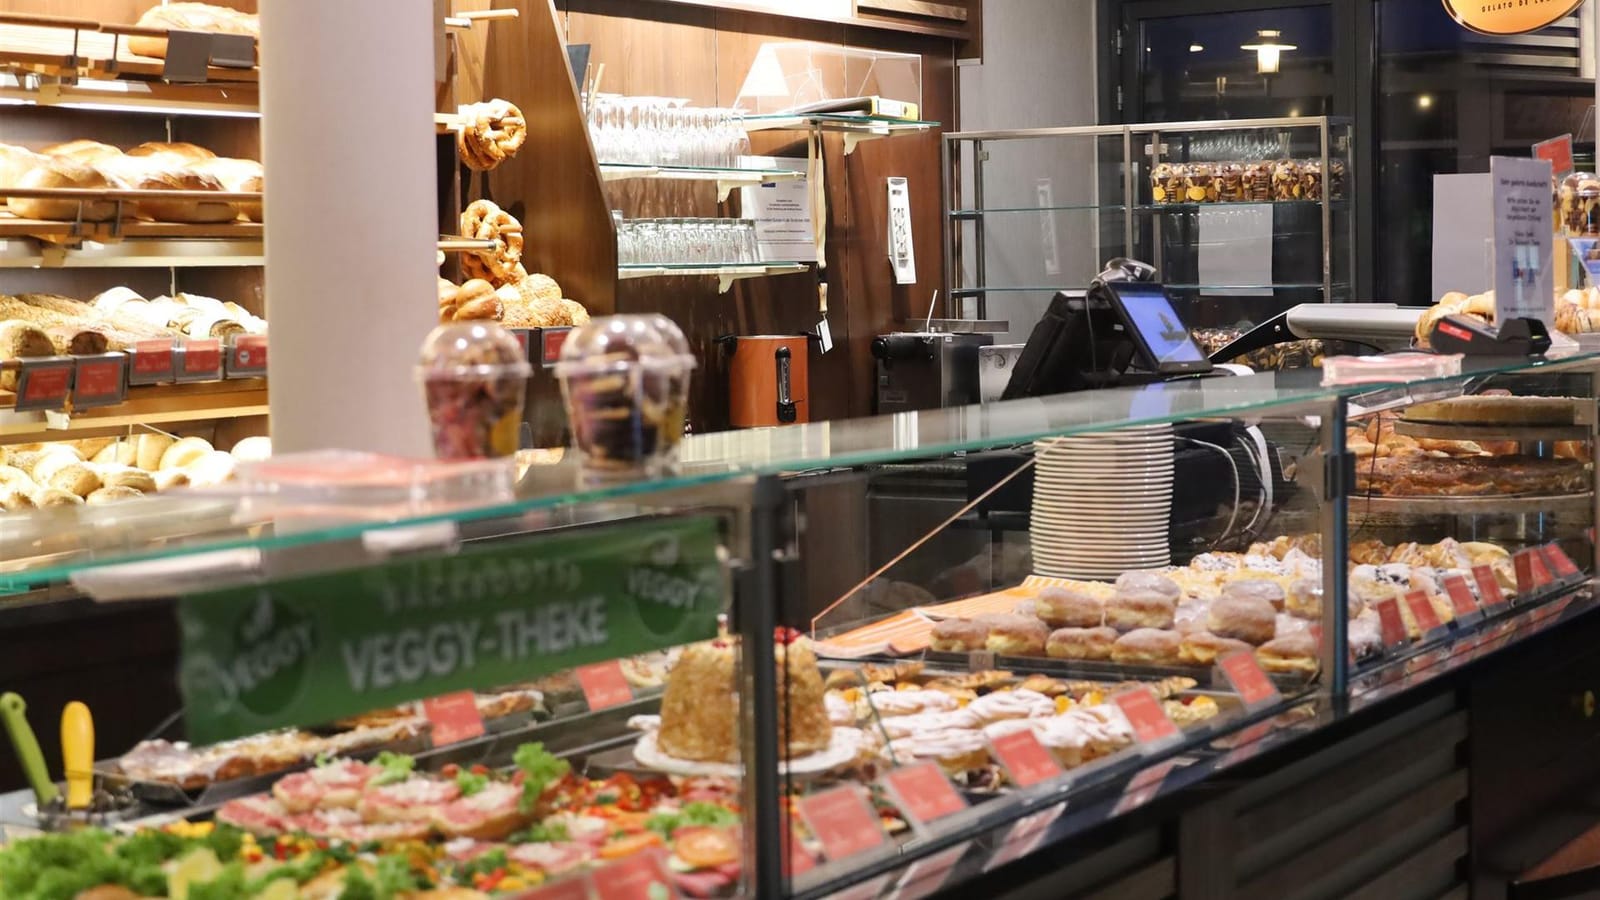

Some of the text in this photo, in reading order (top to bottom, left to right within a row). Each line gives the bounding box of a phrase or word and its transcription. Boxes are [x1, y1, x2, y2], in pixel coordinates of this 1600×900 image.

[1481, 1, 1513, 13] GELATO
[628, 567, 700, 609] VEGGY
[341, 596, 609, 692] VEGGY-THEKE
